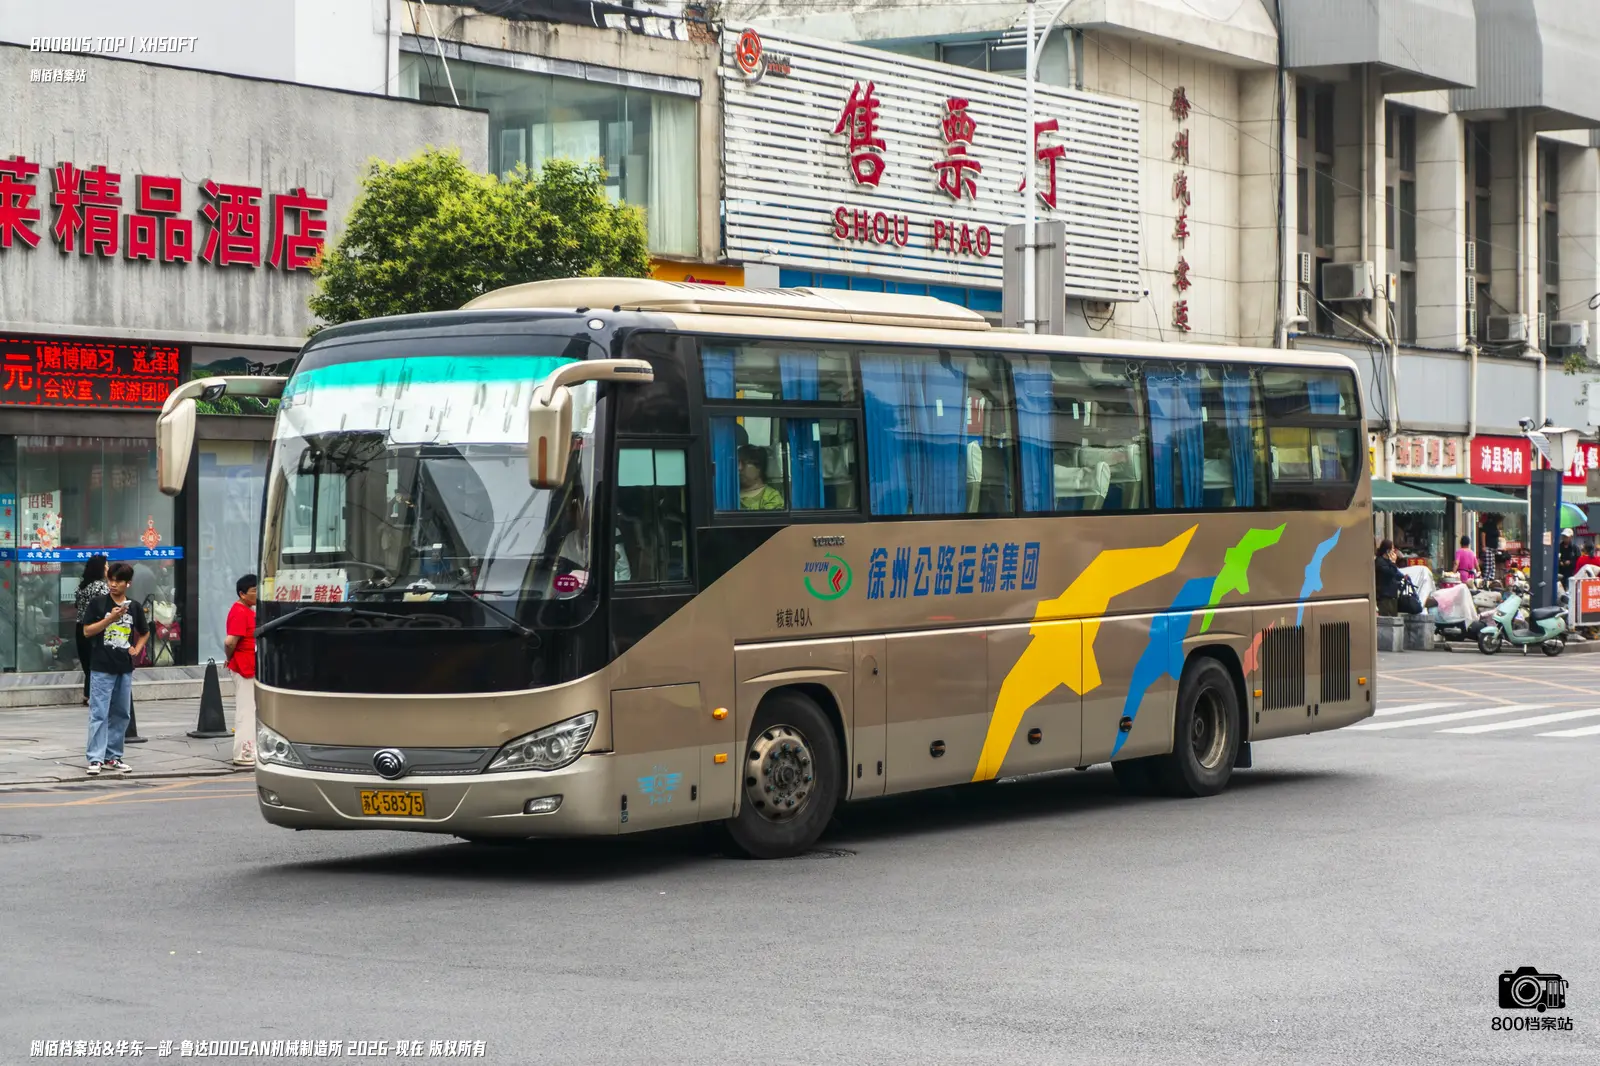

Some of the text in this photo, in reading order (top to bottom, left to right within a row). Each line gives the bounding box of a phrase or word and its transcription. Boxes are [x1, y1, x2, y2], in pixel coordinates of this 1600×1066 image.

[830, 80, 1066, 209] 售票厅
[833, 206, 991, 257] SHOU PIAO
[4, 353, 32, 391] 元
[1481, 445, 1523, 474] 沛县狗肉
[28, 492, 53, 509] 招聘
[803, 561, 830, 573] XUYUN
[867, 542, 1041, 600] 徐州公路运输集团
[776, 607, 813, 628] 核载49人
